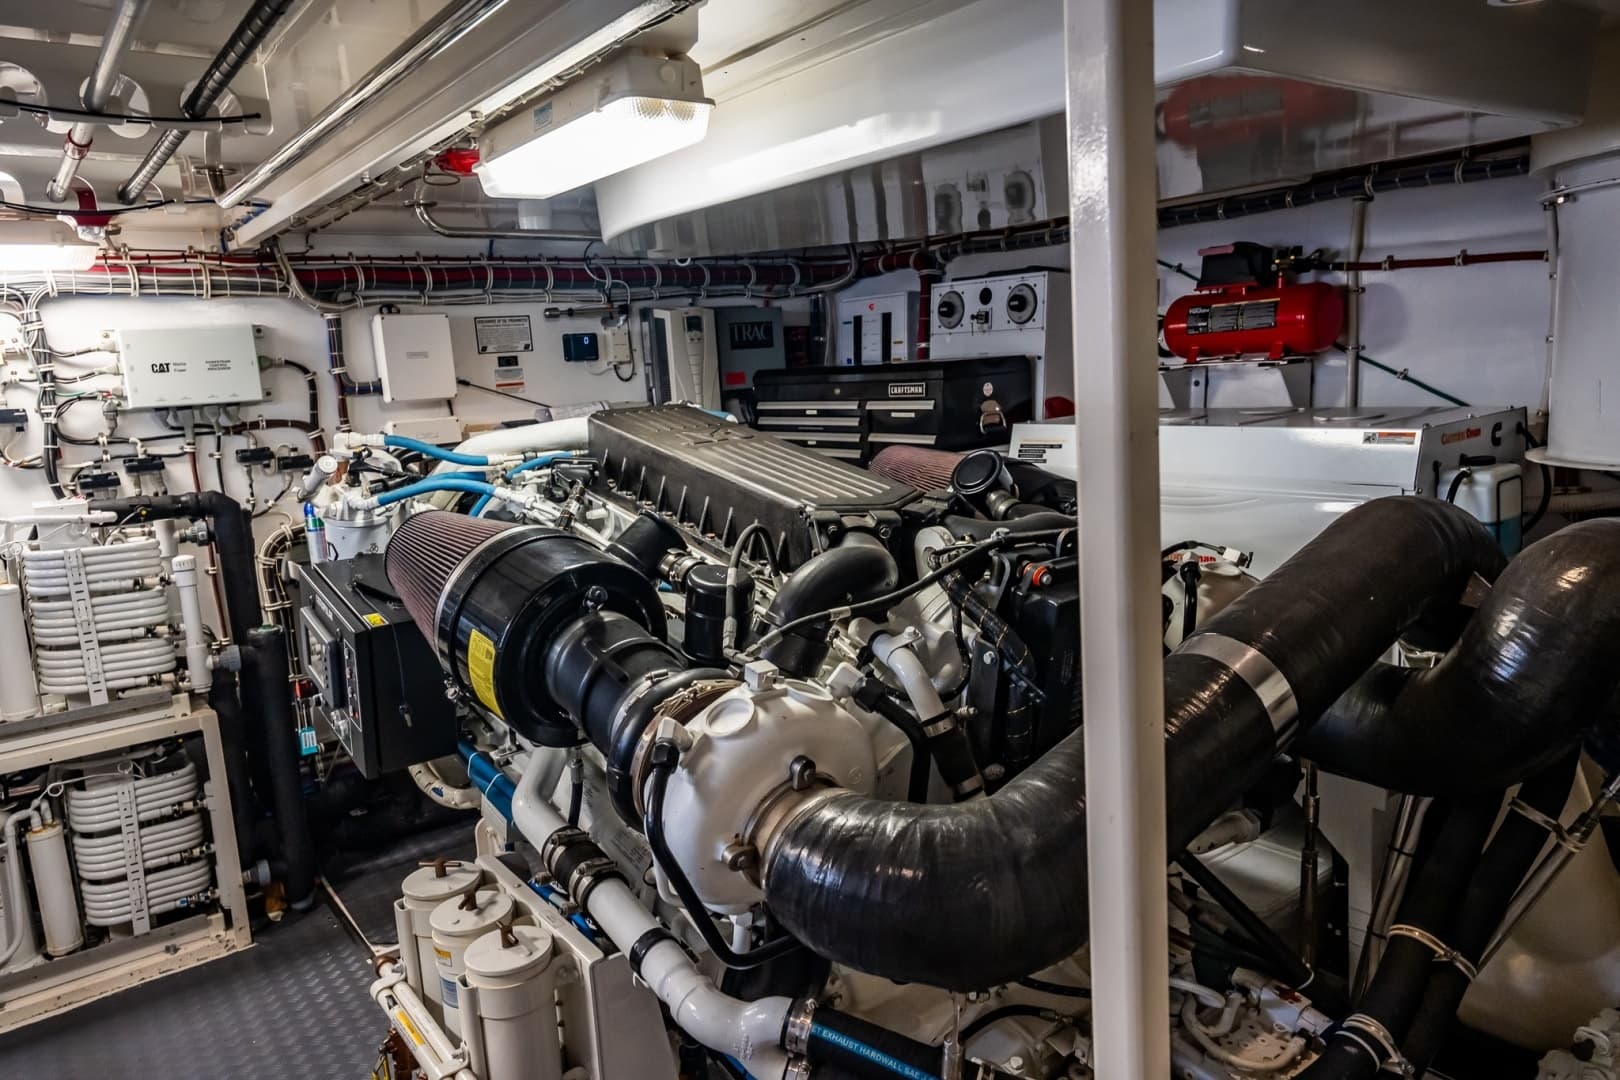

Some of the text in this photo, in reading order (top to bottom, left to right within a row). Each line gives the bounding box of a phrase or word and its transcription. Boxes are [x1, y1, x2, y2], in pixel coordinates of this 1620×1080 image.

[732, 323, 769, 341] TRAC
[151, 362, 170, 373] CAT
[822, 1029, 859, 1051] EXHAUST
[859, 1046, 903, 1072] HARDWALL
